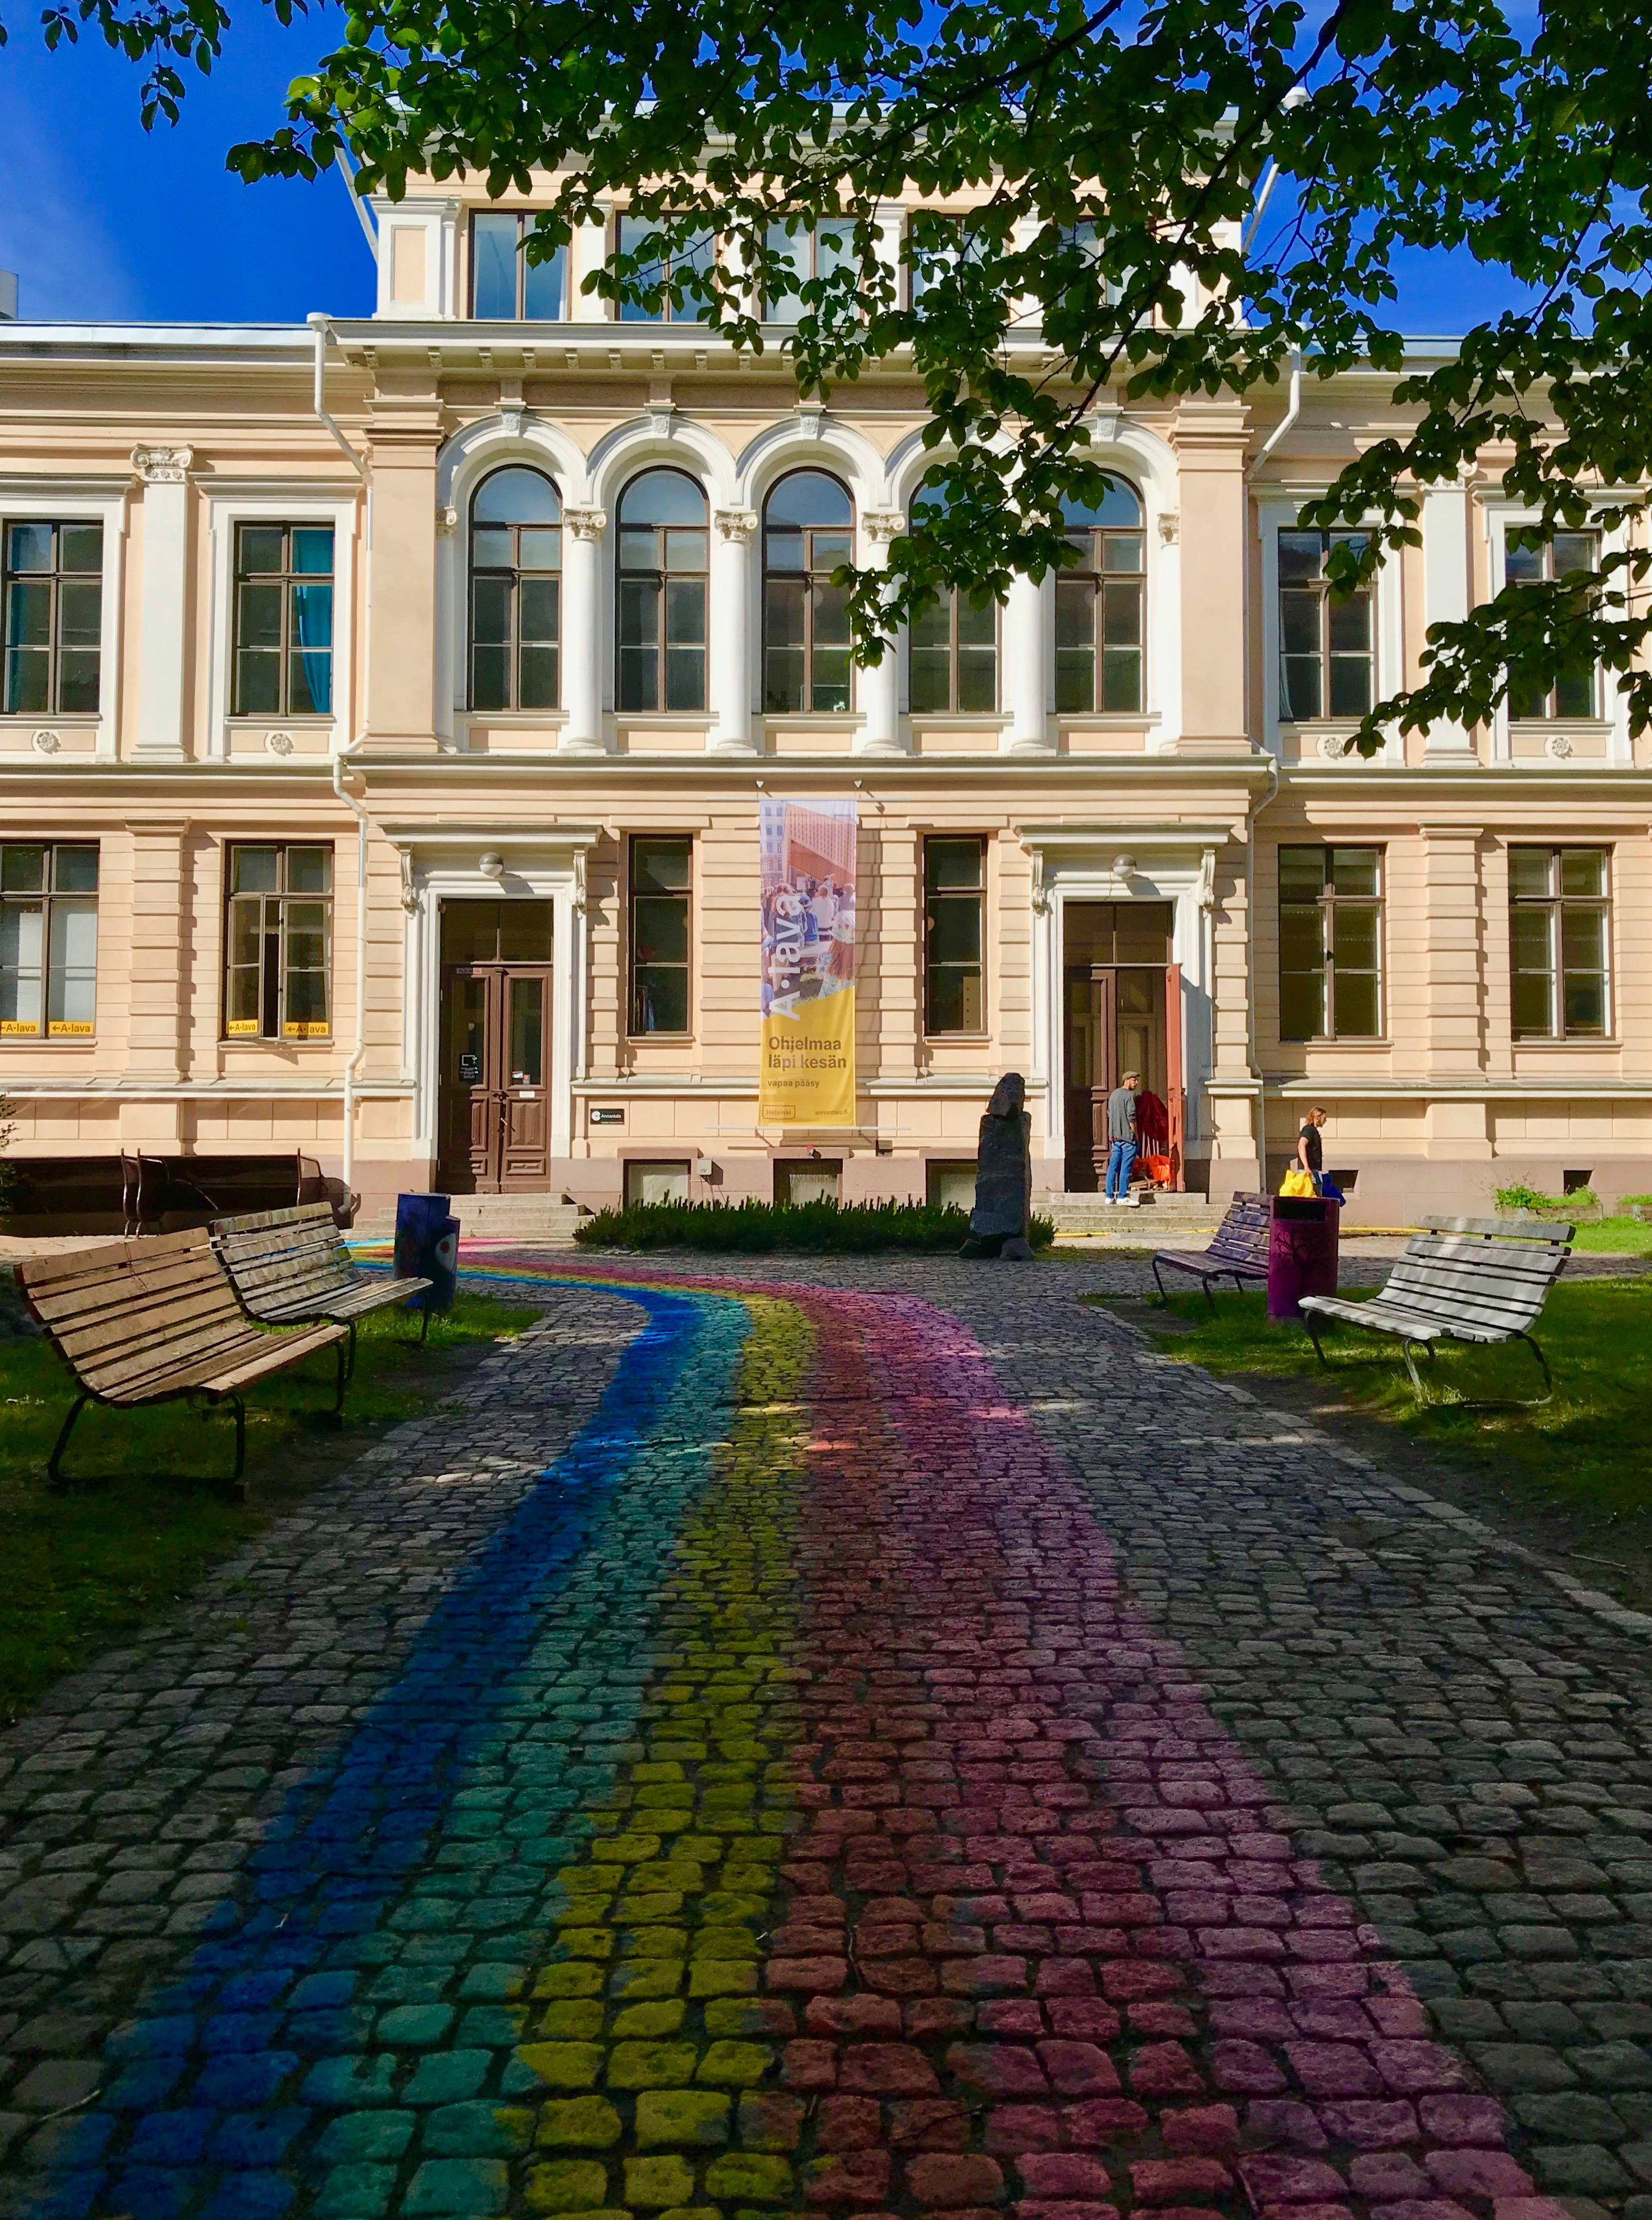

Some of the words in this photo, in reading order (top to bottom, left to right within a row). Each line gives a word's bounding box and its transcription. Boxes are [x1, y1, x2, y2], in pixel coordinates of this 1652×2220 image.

[768, 1036, 841, 1053] Ohjelmaa
[768, 1054, 796, 1072] läpi
[800, 1054, 847, 1068] kesän
[794, 1079, 820, 1088] pääsy
